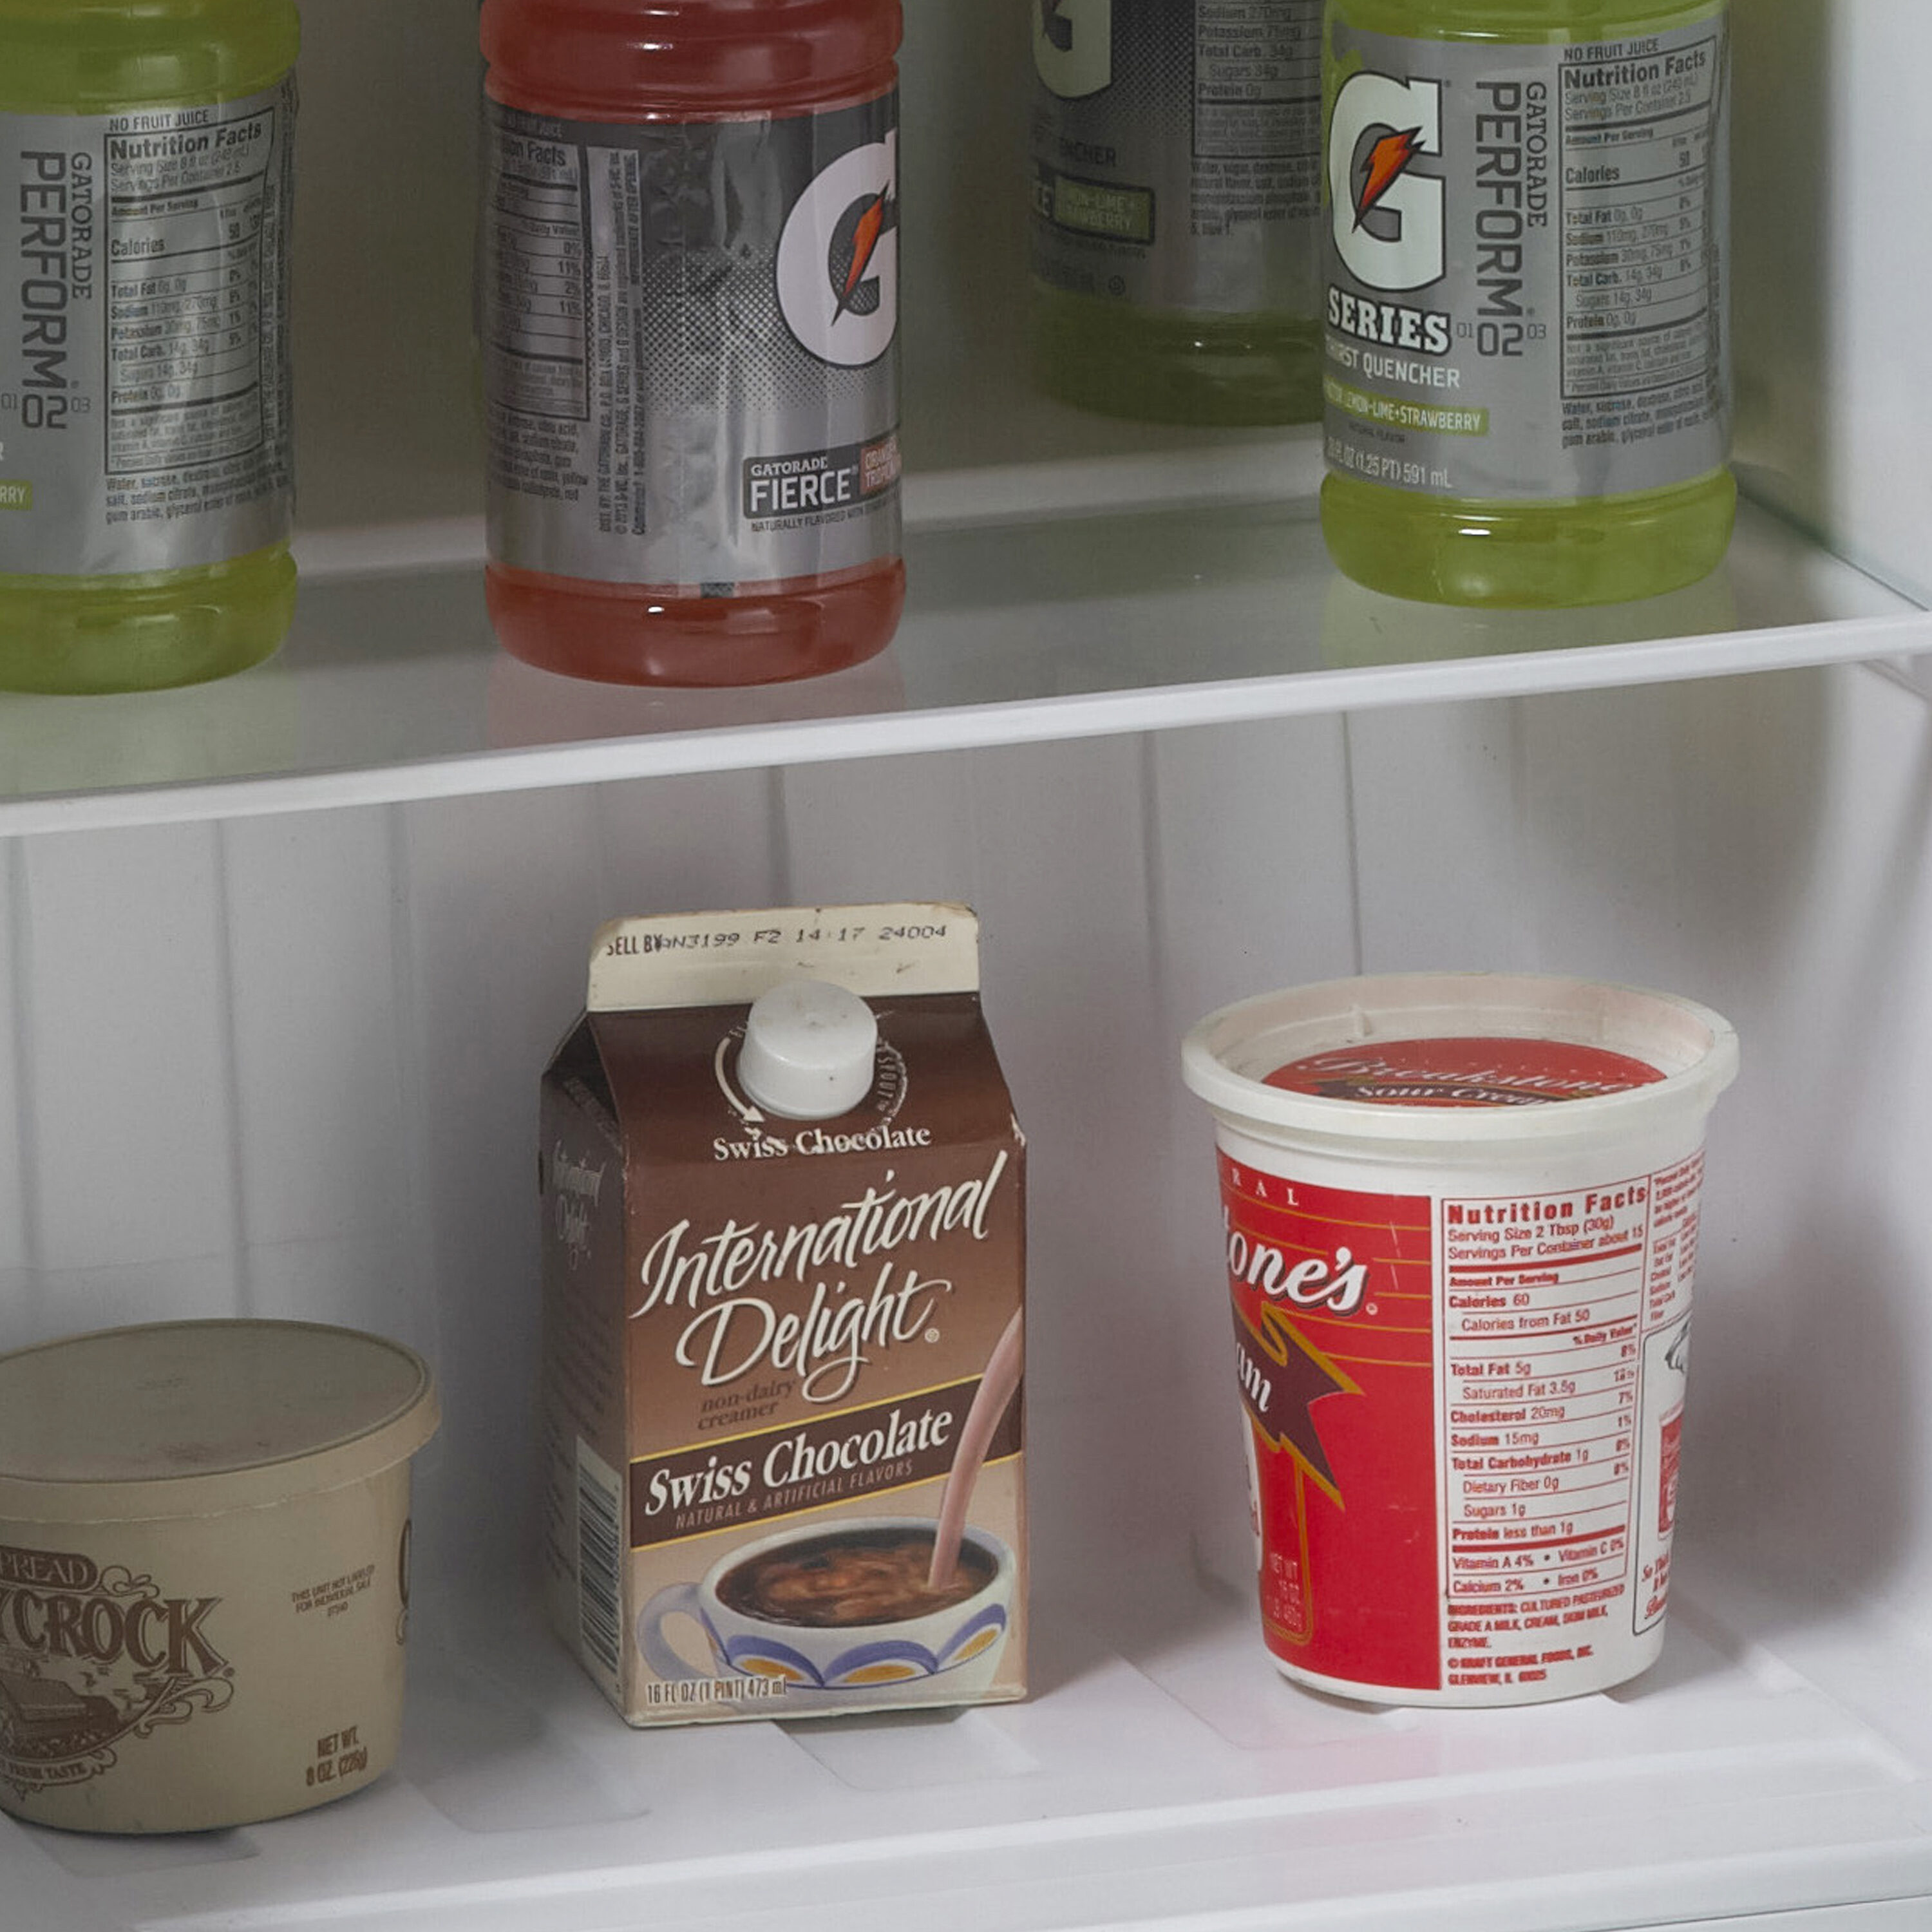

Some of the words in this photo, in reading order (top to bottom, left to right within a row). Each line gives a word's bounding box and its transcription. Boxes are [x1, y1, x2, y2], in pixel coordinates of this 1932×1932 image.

[1198, 44, 1229, 58] Total
[1564, 48, 1583, 62] NO
[1587, 44, 1623, 60] FRUIT
[1627, 38, 1659, 55] JUICE
[1564, 63, 1659, 89] Nutrition
[1665, 50, 1706, 76] Facts
[109, 118, 129, 131] NO
[133, 113, 171, 130] FRUIT
[175, 109, 209, 128] JUICE
[1615, 103, 1633, 117] Per
[110, 134, 209, 160] Nutrition
[214, 122, 262, 148] Facts
[527, 140, 567, 167] Facts
[1526, 82, 1548, 227] GATORADE
[1329, 69, 1446, 293] G
[1566, 164, 1620, 185] Calories
[1475, 82, 1523, 317] PERFORM
[71, 152, 93, 300] GATORADE
[1566, 211, 1593, 225] Total
[1595, 208, 1612, 223] Fat
[111, 238, 166, 256] Calories
[776, 130, 898, 368] G
[20, 151, 67, 389] PERFORM
[1566, 272, 1593, 287] Total
[111, 284, 138, 300] Total
[1328, 284, 1450, 355] SERIES
[1477, 323, 1524, 356] 02
[1526, 324, 1547, 340] 03
[111, 346, 138, 361] Total
[1363, 352, 1461, 388] QUENCHER
[21, 393, 68, 430] 02
[71, 397, 91, 413] 03
[750, 456, 828, 477] GATORADE
[1404, 464, 1426, 484] 591
[1430, 468, 1451, 489] mL
[750, 468, 851, 513] FIERCE
[751, 516, 804, 533] NATURALLY
[754, 929, 782, 945] F2
[878, 925, 947, 941] 24004
[714, 1135, 790, 1161] Swiss
[796, 1126, 933, 1157] Chocolate
[1448, 1200, 1573, 1225] Nutrition
[1585, 1186, 1647, 1215] Facts
[629, 1150, 1009, 1320] International
[1448, 1229, 1500, 1244] Serving
[1504, 1227, 1532, 1242] Size
[1535, 1225, 1544, 1238] 2
[1549, 1222, 1579, 1237] Tbsp
[1583, 1215, 1615, 1234] (30g)
[1448, 1246, 1506, 1262] Servings
[1510, 1243, 1533, 1256] Per
[1537, 1238, 1595, 1255] Container
[1598, 1231, 1629, 1247] about
[1632, 1225, 1643, 1238] 15
[1449, 1276, 1493, 1287] Amount
[1495, 1275, 1515, 1286] Per
[1519, 1272, 1560, 1285] Serving
[1449, 1294, 1507, 1308] Calories
[1513, 1293, 1530, 1306] 60
[675, 1261, 952, 1403] Delight
[1461, 1316, 1515, 1332] Calories
[1519, 1314, 1549, 1329] from
[1553, 1312, 1572, 1325] Fat
[1575, 1309, 1591, 1322] 50
[1450, 1363, 1484, 1376] Total
[1488, 1363, 1510, 1375] Fat
[1515, 1361, 1531, 1376] 5g
[701, 1378, 796, 1414] non-dairy
[1463, 1385, 1524, 1400] Saturated
[1528, 1383, 1546, 1396] Fat
[1549, 1379, 1577, 1395] 3.5g
[1618, 1390, 1634, 1405] 7%
[697, 1400, 780, 1431] creamer
[1450, 1408, 1527, 1423] Cholesterol
[1530, 1406, 1566, 1419] 20mg
[1617, 1415, 1632, 1428] 1%
[1451, 1433, 1500, 1447] Sodium
[1504, 1432, 1540, 1446] 15mg
[645, 1455, 753, 1517] Swiss
[762, 1408, 953, 1489] Chocolate
[1451, 1457, 1484, 1471] Total
[1488, 1450, 1572, 1470] Carbohydrate
[1577, 1449, 1589, 1462] 1g
[675, 1504, 743, 1531] NATURAL
[747, 1499, 758, 1514] &
[762, 1477, 843, 1510] ARTIFICIAL
[849, 1459, 914, 1488] FLAVORS
[1463, 1479, 1506, 1495] Dietary
[1510, 1478, 1541, 1492] Fiber
[1543, 1475, 1560, 1492] 0g
[1463, 1504, 1506, 1520] Sugars
[1511, 1502, 1527, 1518] 1g
[1453, 1528, 1500, 1541] Protein
[1503, 1526, 1527, 1539] less
[1531, 1522, 1557, 1537] than
[1560, 1520, 1574, 1536] 1g
[0, 1551, 89, 1585] PREAD
[1453, 1557, 1499, 1570] Vitamin
[1502, 1556, 1512, 1569] A
[1514, 1554, 1535, 1567] 4%
[1558, 1546, 1598, 1563] Vitamin
[1600, 1541, 1608, 1555] C
[1453, 1580, 1501, 1593] Calcium
[1504, 1578, 1524, 1592] 2%
[1557, 1573, 1580, 1586] Iron
[12, 1588, 230, 1676] CROCK
[1484, 1620, 1493, 1632] A
[647, 1684, 661, 1704] 16
[665, 1682, 676, 1703] FL
[681, 1681, 696, 1703] OZ
[714, 1677, 745, 1701] PINT)
[748, 1676, 770, 1698] 473
[317, 1733, 339, 1758] NET
[306, 1765, 315, 1786] 8
